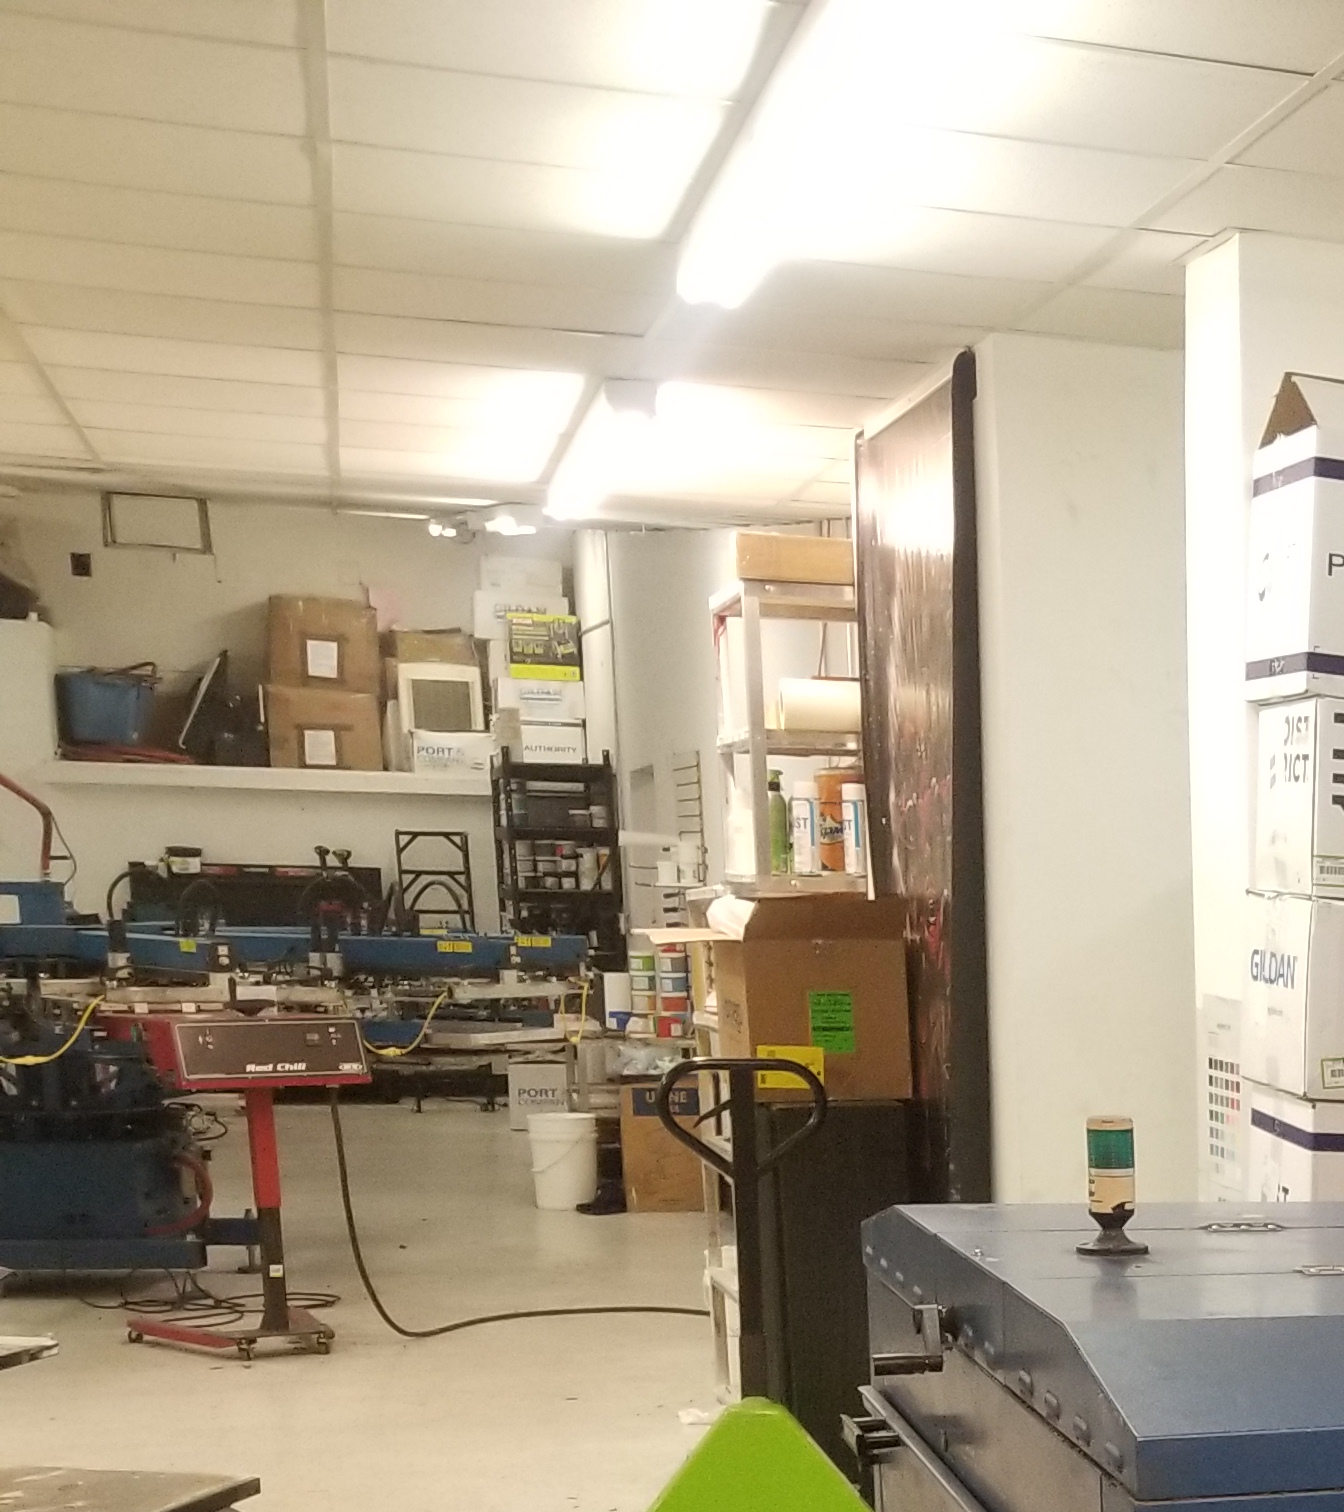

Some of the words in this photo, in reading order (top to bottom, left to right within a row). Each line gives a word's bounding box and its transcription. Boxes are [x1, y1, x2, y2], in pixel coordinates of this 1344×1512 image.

[417, 746, 453, 756] PORT
[1251, 949, 1295, 989] GILDAN
[246, 1063, 273, 1072] Red
[277, 1062, 306, 1071] Chili
[518, 1088, 558, 1098] PORT
